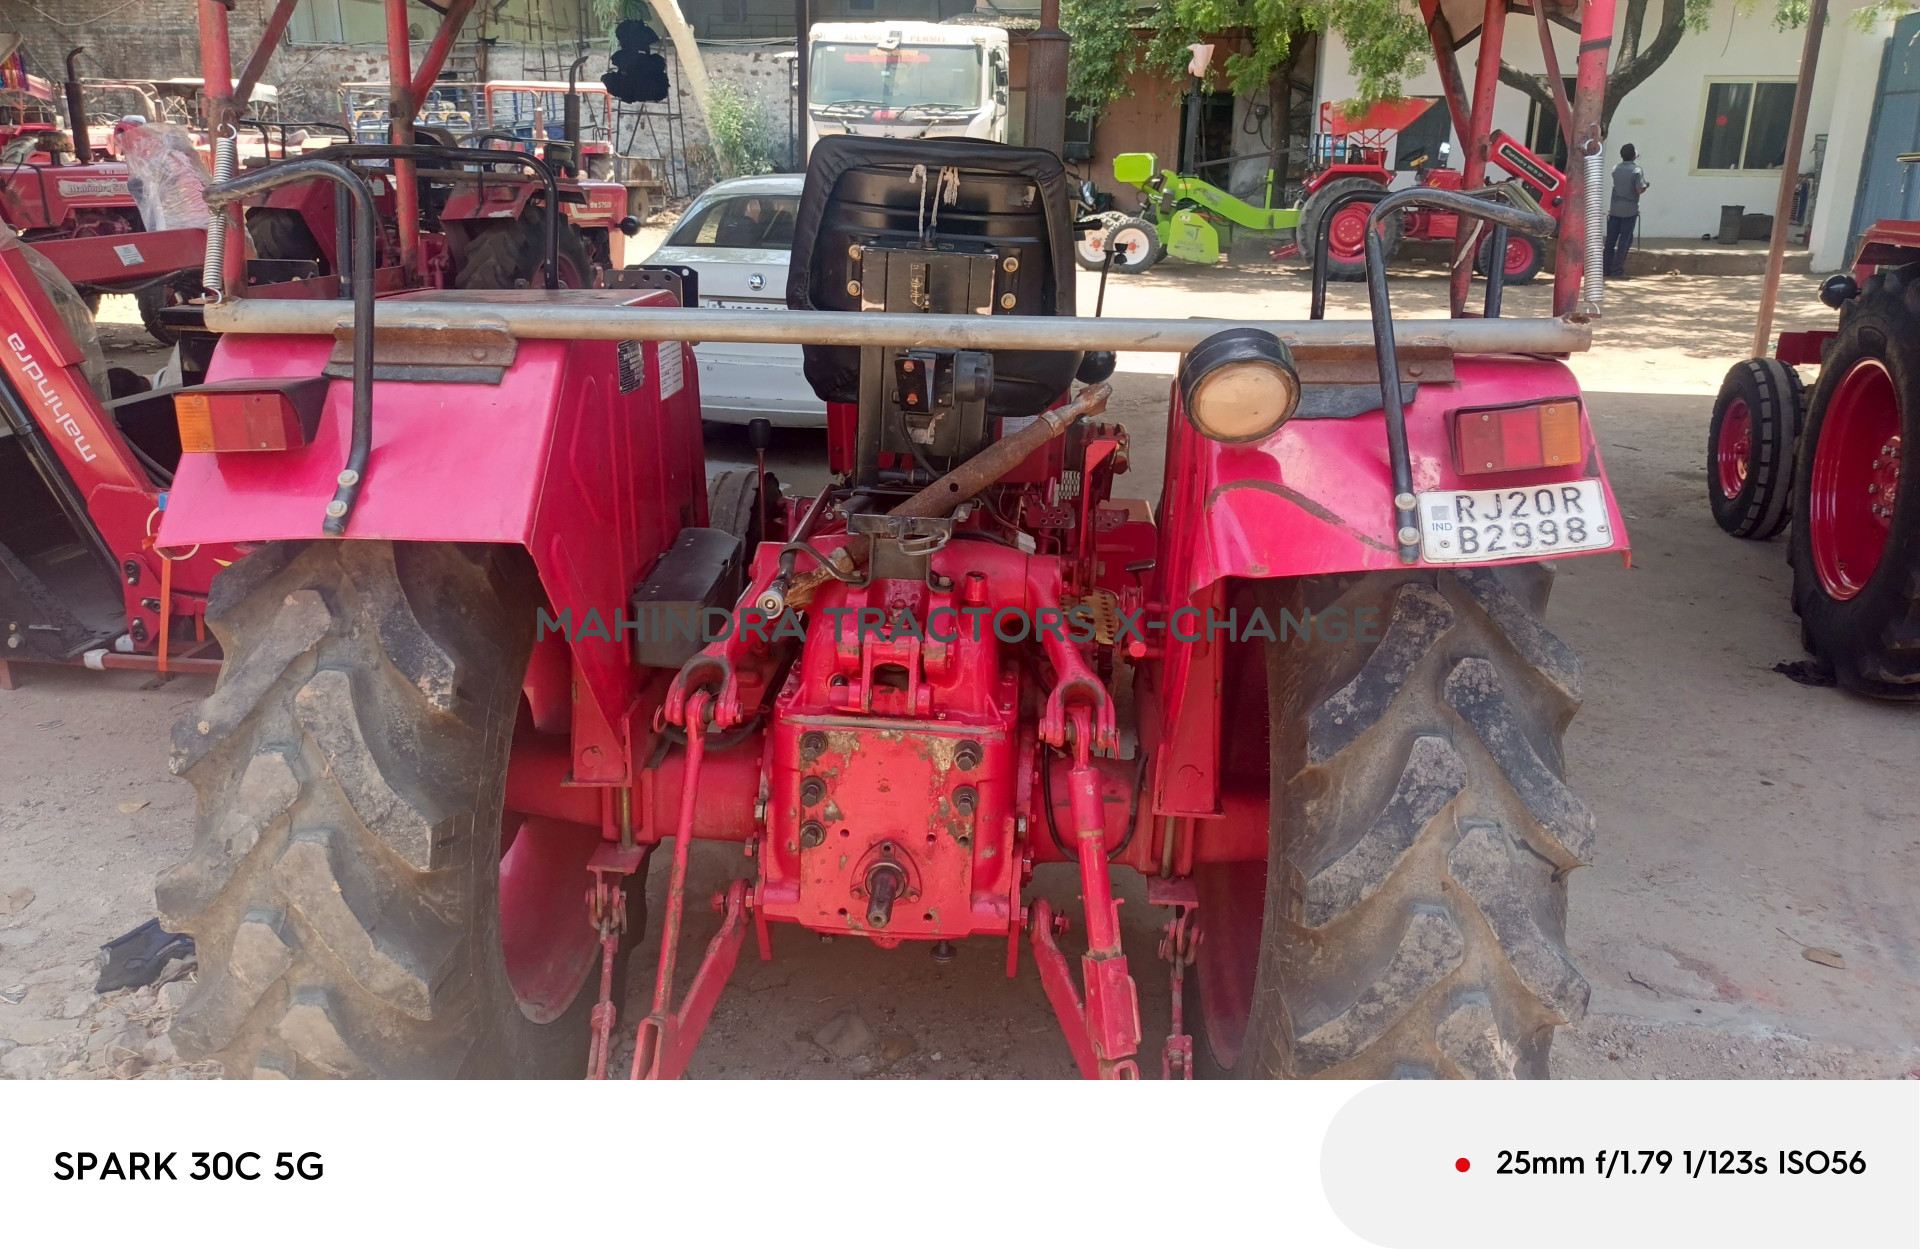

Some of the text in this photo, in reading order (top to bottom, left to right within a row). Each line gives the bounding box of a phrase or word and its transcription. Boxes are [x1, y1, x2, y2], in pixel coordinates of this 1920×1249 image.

[910, 35, 946, 43] PERMIT
[7, 332, 97, 463] mahindra
[1455, 486, 1584, 524] RJ20R
[1432, 523, 1453, 532] IND
[1457, 517, 1588, 554] B2998
